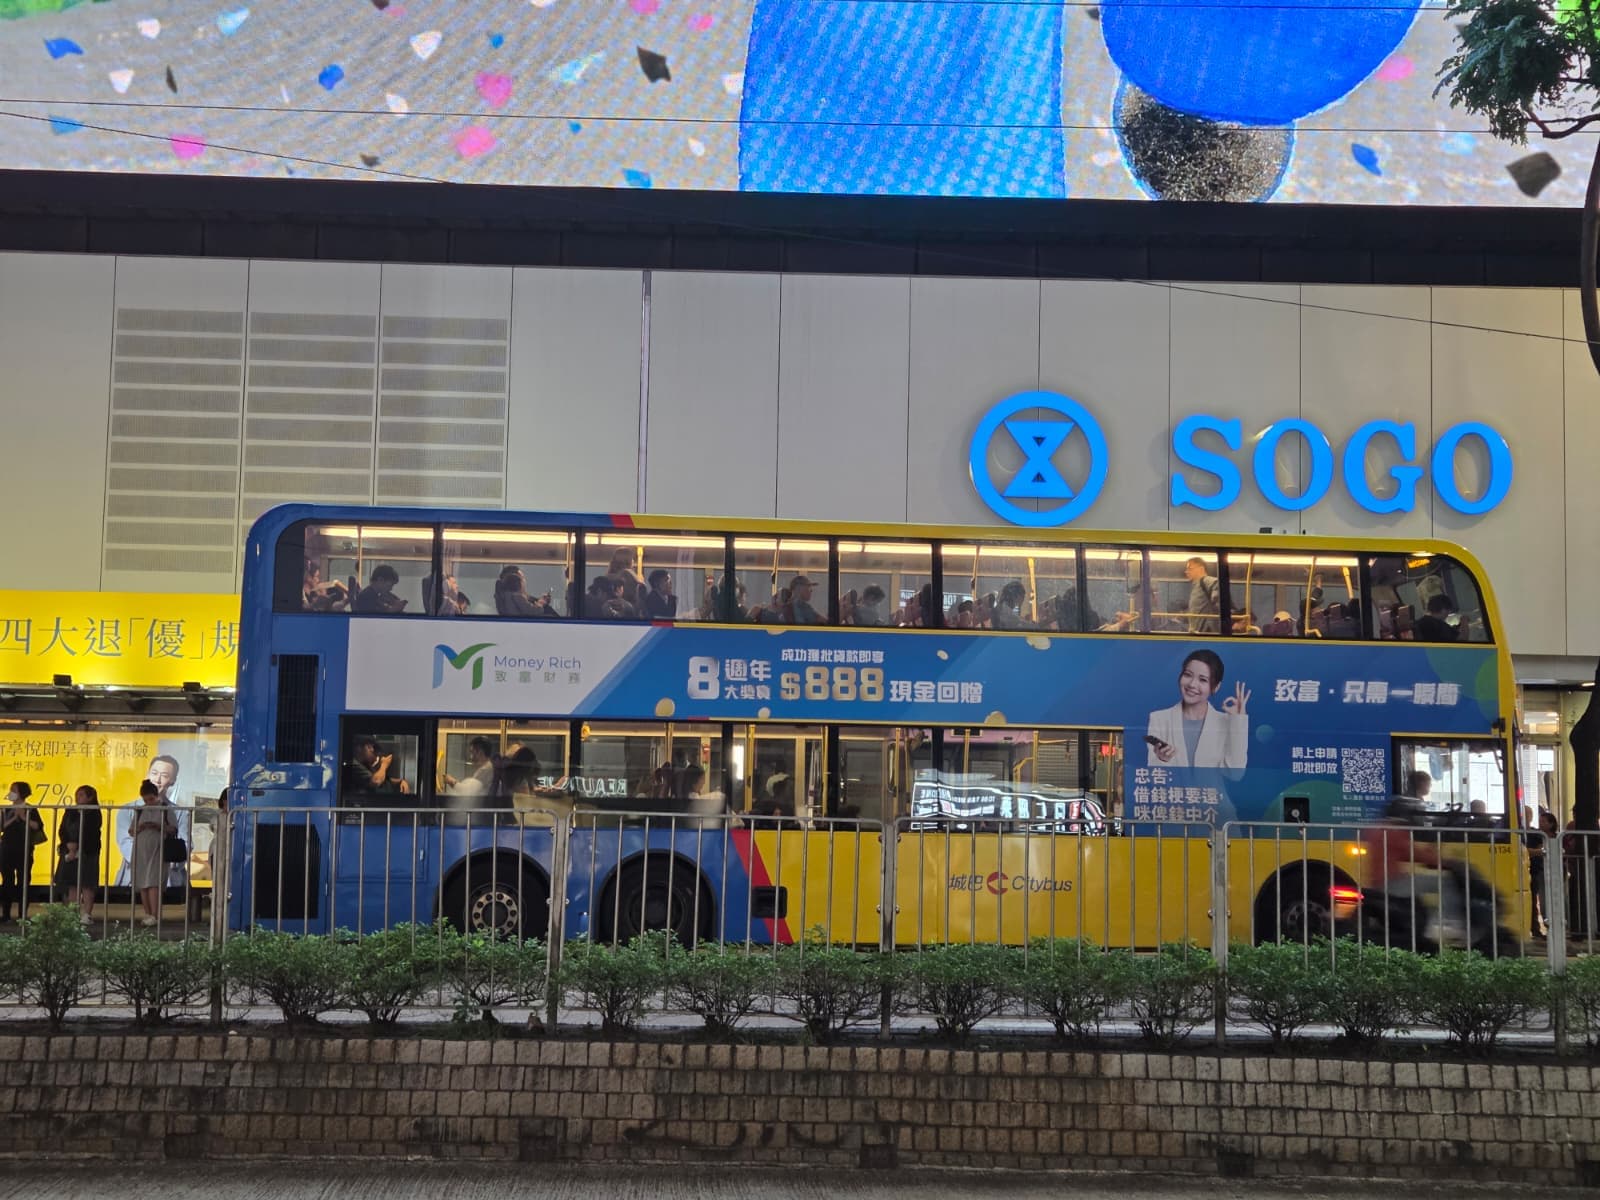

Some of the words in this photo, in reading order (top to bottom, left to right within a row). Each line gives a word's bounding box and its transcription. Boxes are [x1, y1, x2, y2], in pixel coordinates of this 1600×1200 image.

[1171, 414, 1513, 515] SOGO
[494, 655, 544, 671] Money
[549, 656, 581, 669] Rich
[724, 658, 772, 682] 週年
[687, 656, 720, 700] 8
[780, 666, 884, 702] $888
[889, 680, 983, 704] 現金回贈
[1291, 747, 1337, 759] 網上申請
[1292, 762, 1338, 774] 即批即放
[1012, 875, 1073, 893] Citybus
